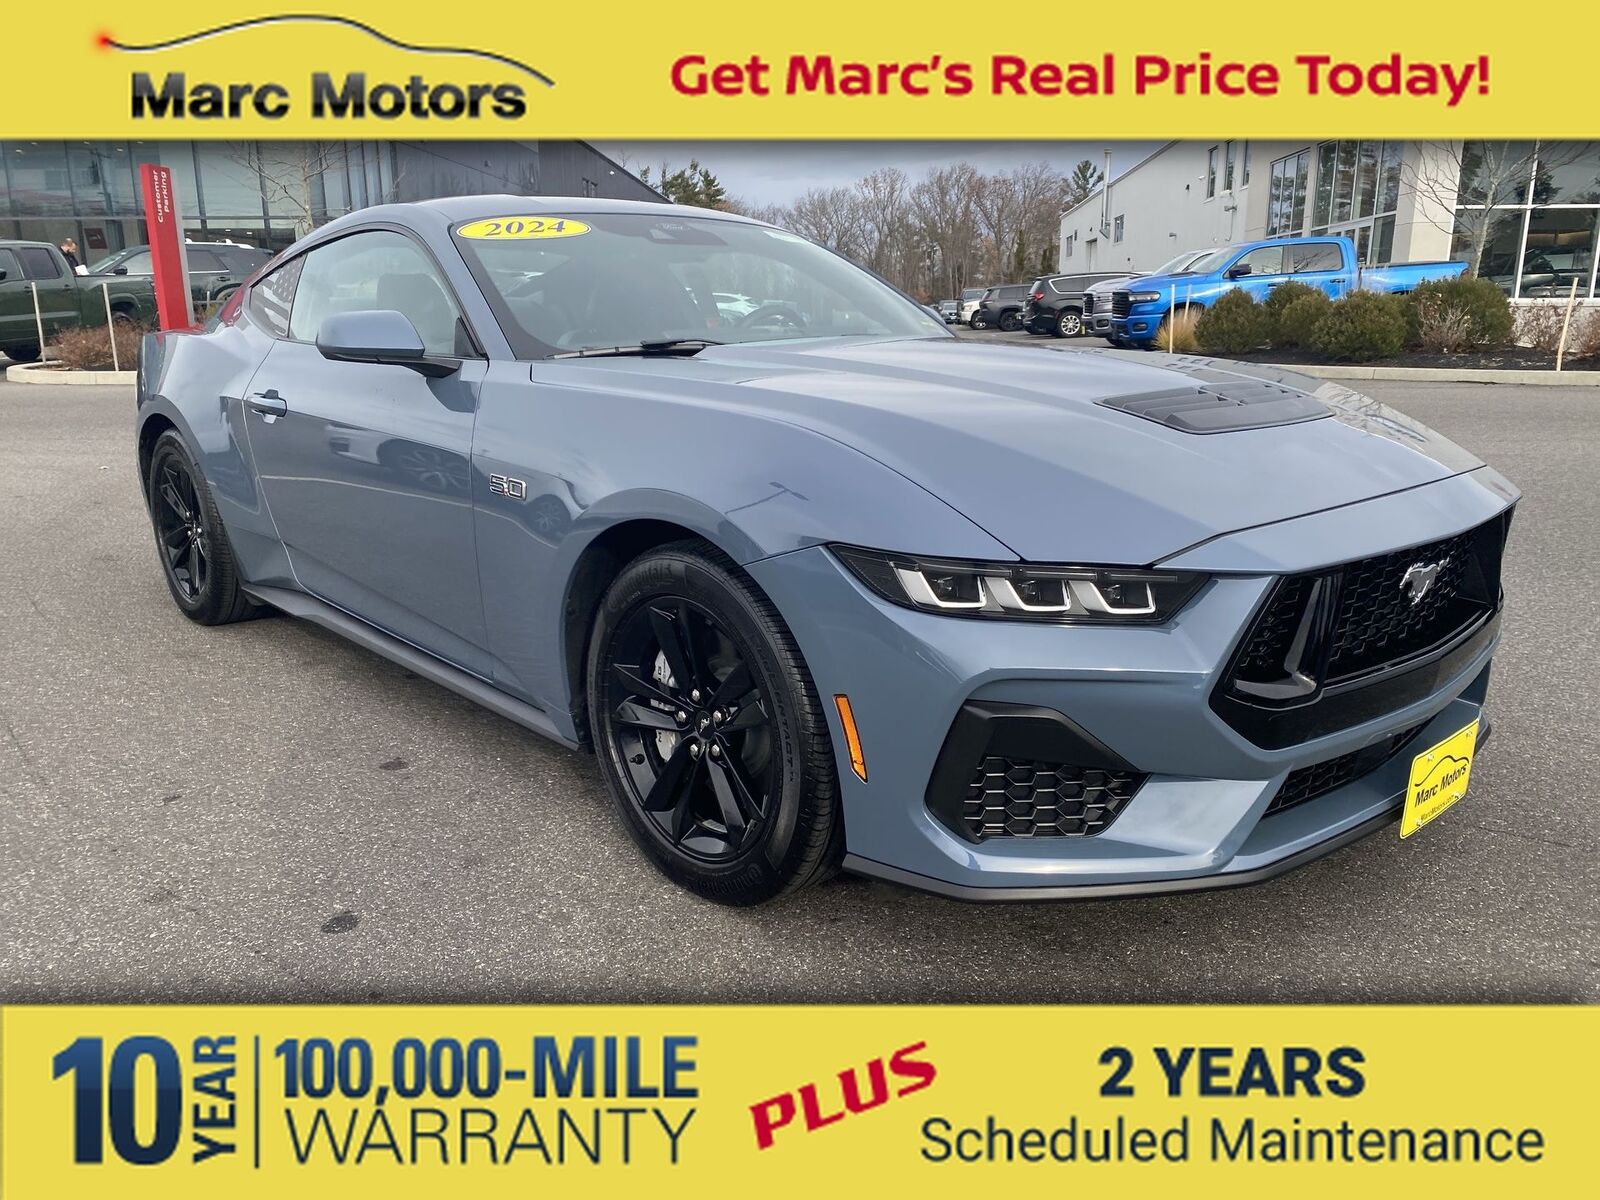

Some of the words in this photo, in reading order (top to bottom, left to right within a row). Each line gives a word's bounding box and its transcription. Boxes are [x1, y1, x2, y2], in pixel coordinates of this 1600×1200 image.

[152, 169, 163, 223] Customer
[483, 220, 567, 237] 2024
[1414, 784, 1439, 809] Marc
[1440, 763, 1468, 792] Motors
